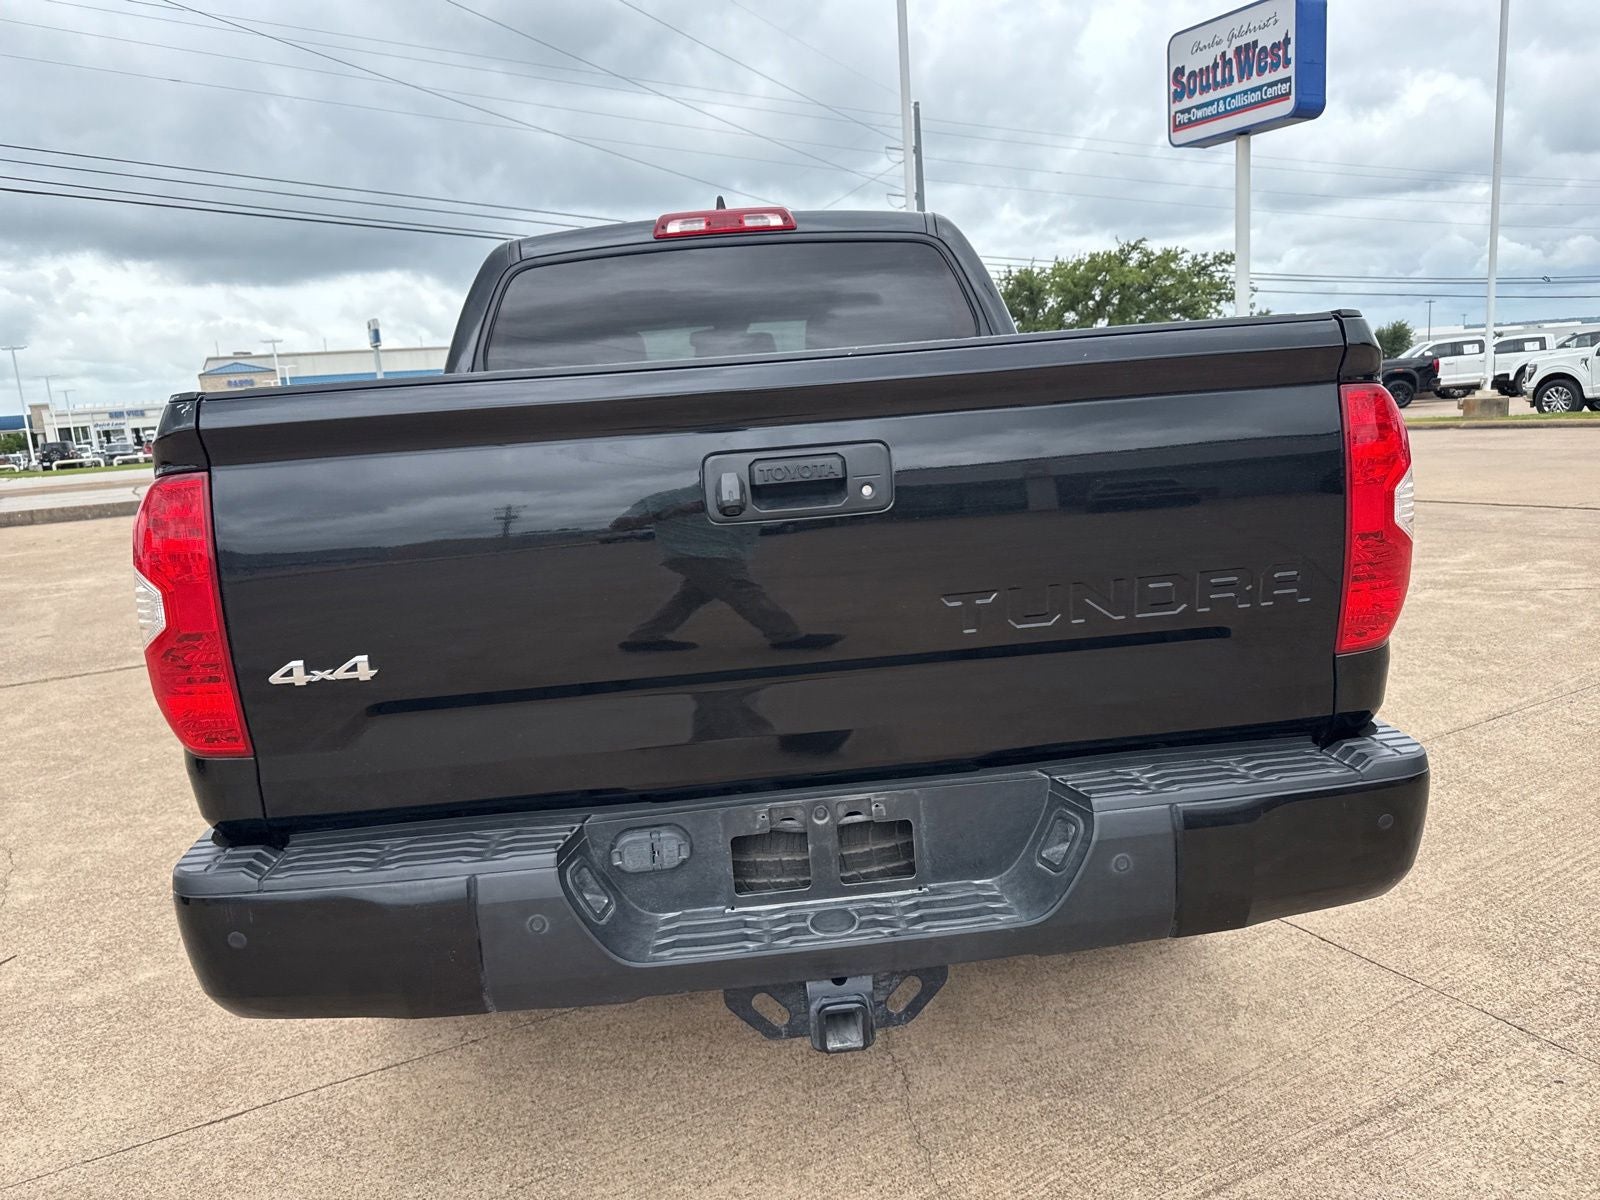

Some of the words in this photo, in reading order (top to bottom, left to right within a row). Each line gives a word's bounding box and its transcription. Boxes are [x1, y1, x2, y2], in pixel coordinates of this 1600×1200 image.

[1172, 29, 1292, 104] SouthWest
[1175, 103, 1218, 126] Pre-Owned
[1218, 102, 1225, 113] &
[1225, 92, 1261, 111] Collision
[1262, 81, 1291, 99] Center
[758, 463, 840, 482] TOYOTA
[941, 563, 1311, 634] TUNDRA
[268, 654, 379, 687] 4x4
